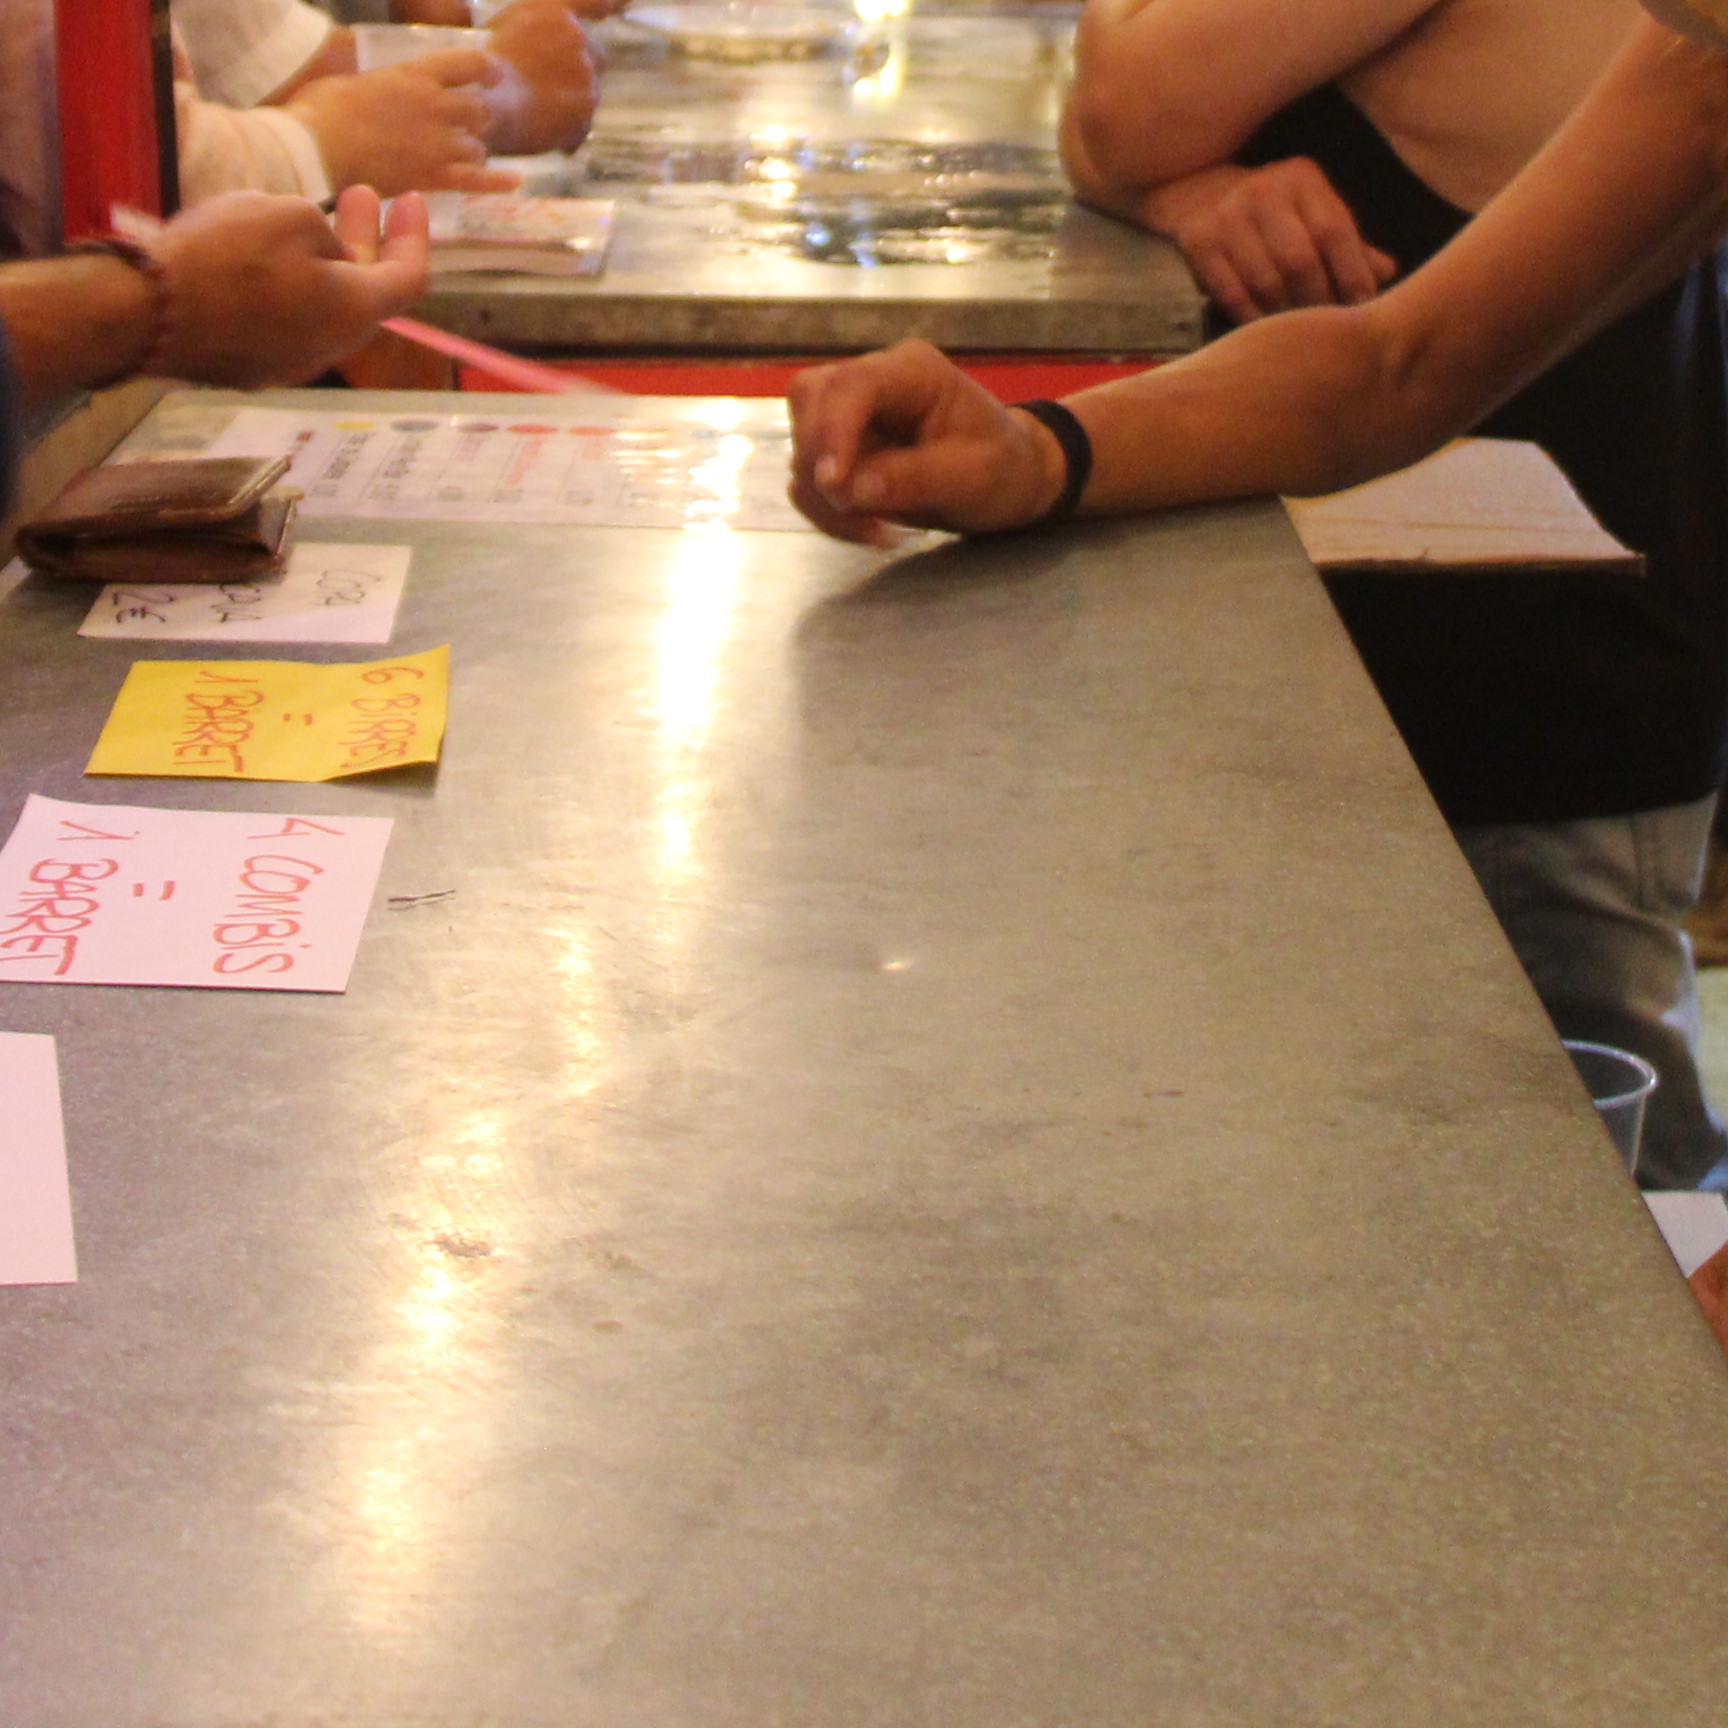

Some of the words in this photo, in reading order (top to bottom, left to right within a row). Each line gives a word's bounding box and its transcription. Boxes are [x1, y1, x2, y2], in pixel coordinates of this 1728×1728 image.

[194, 669, 259, 684] 1
[361, 665, 426, 686] 6
[173, 689, 266, 773] BARRET
[57, 819, 135, 841] 1
[247, 817, 346, 840] 4
